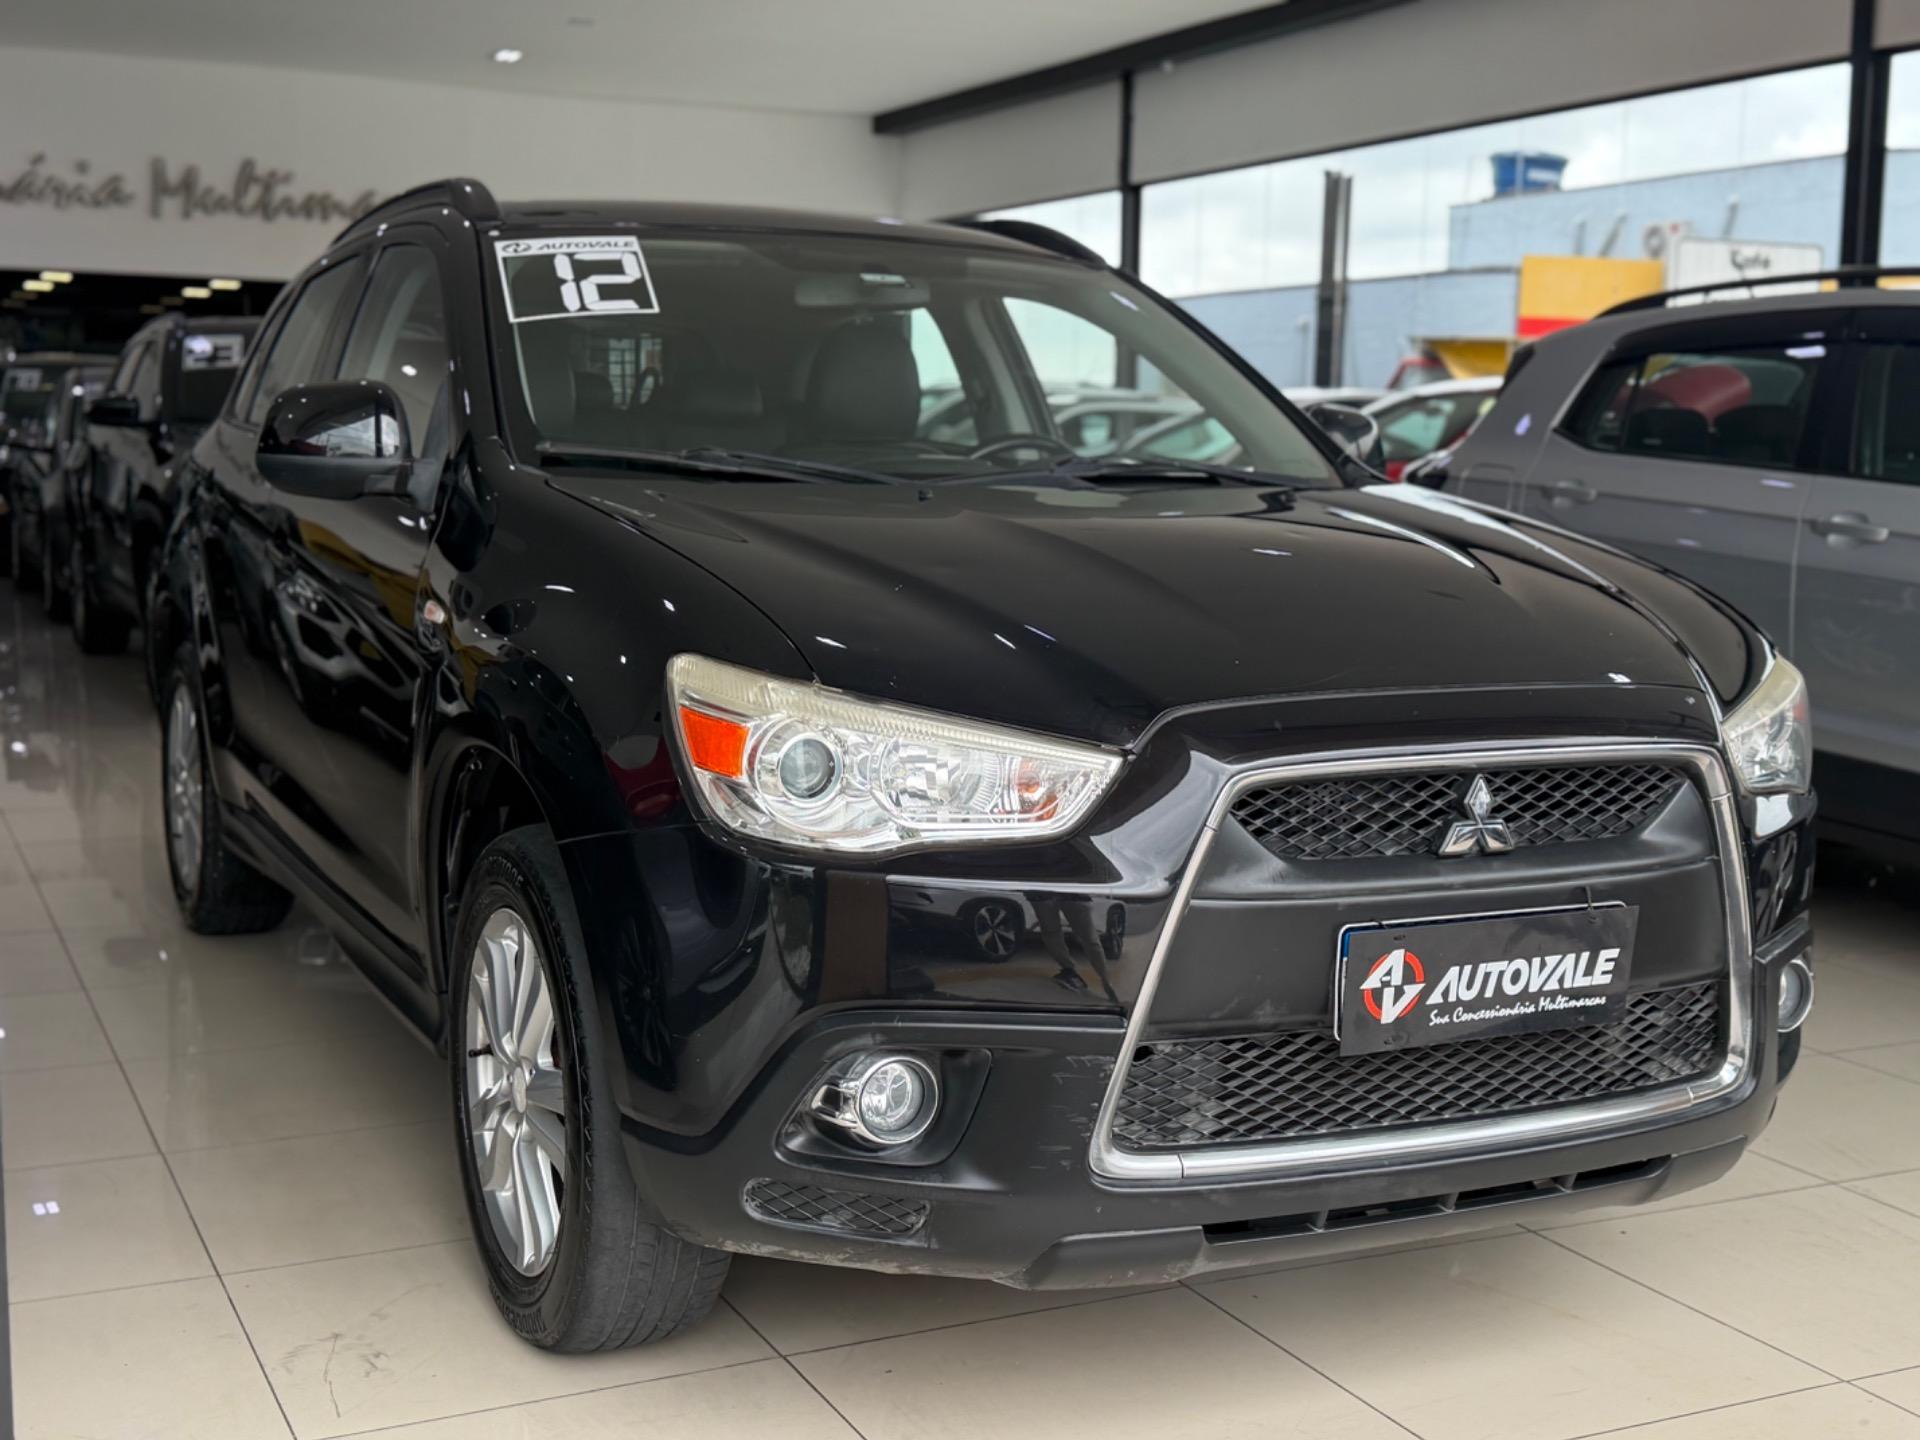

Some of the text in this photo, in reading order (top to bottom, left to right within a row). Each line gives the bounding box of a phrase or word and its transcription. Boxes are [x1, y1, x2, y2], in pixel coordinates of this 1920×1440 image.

[538, 240, 635, 251] AUTOVALE
[553, 252, 642, 312] 12
[1425, 948, 1621, 1006] AUTOVALE
[1428, 994, 1606, 1026] Sua Concessionária Multimarcas
